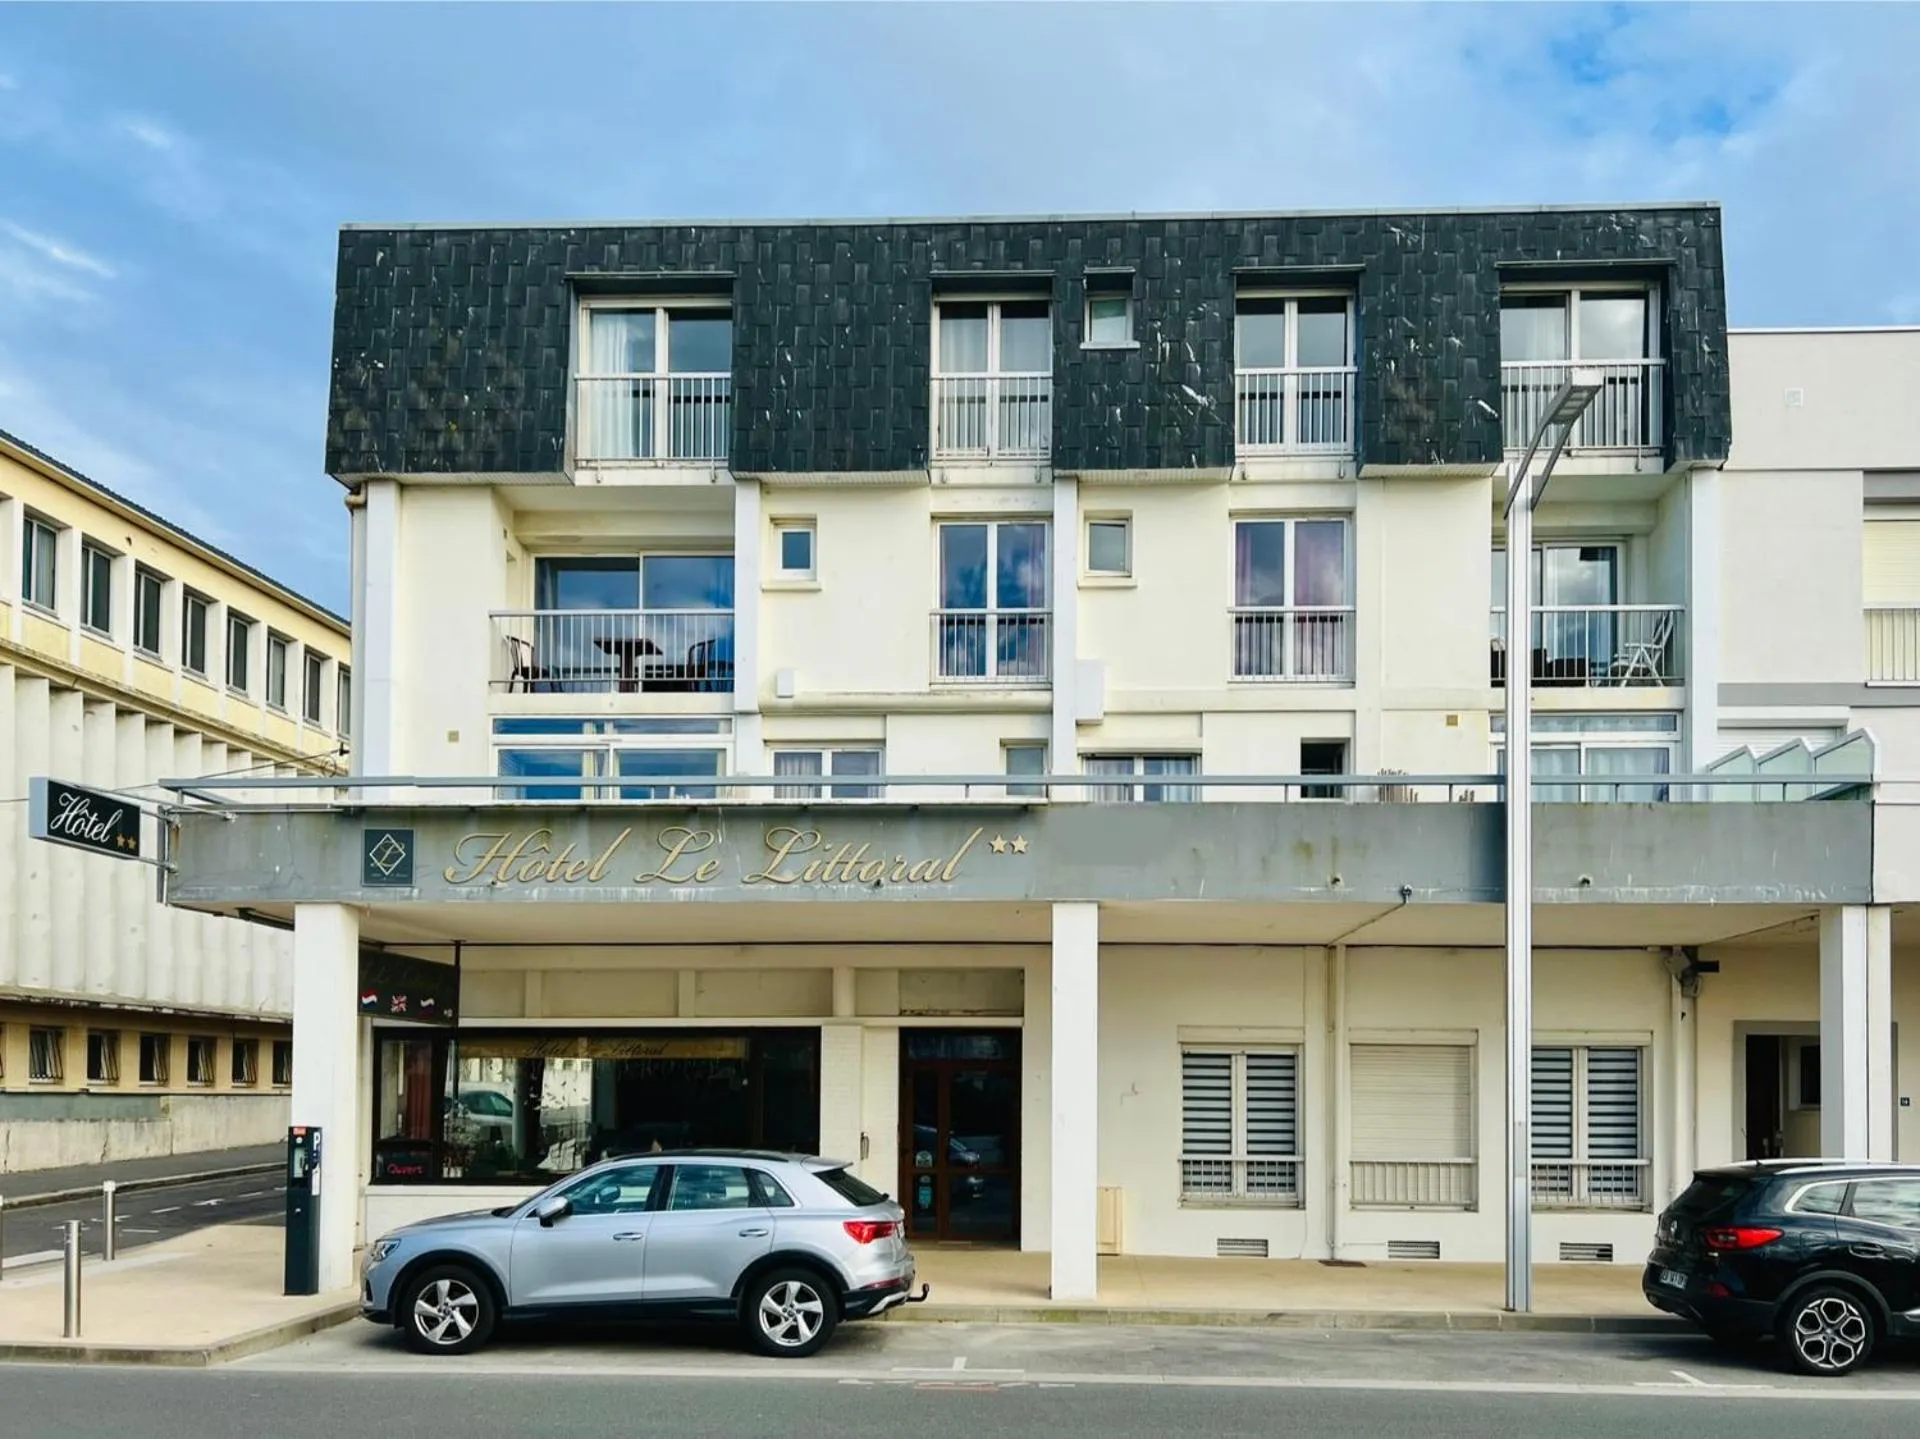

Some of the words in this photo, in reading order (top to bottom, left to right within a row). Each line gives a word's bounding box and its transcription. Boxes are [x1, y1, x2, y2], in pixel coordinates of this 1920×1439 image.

[50, 792, 123, 844] Hôtel
[442, 827, 632, 884] Hôtel
[633, 826, 723, 883] Le
[741, 826, 984, 884] Littoral
